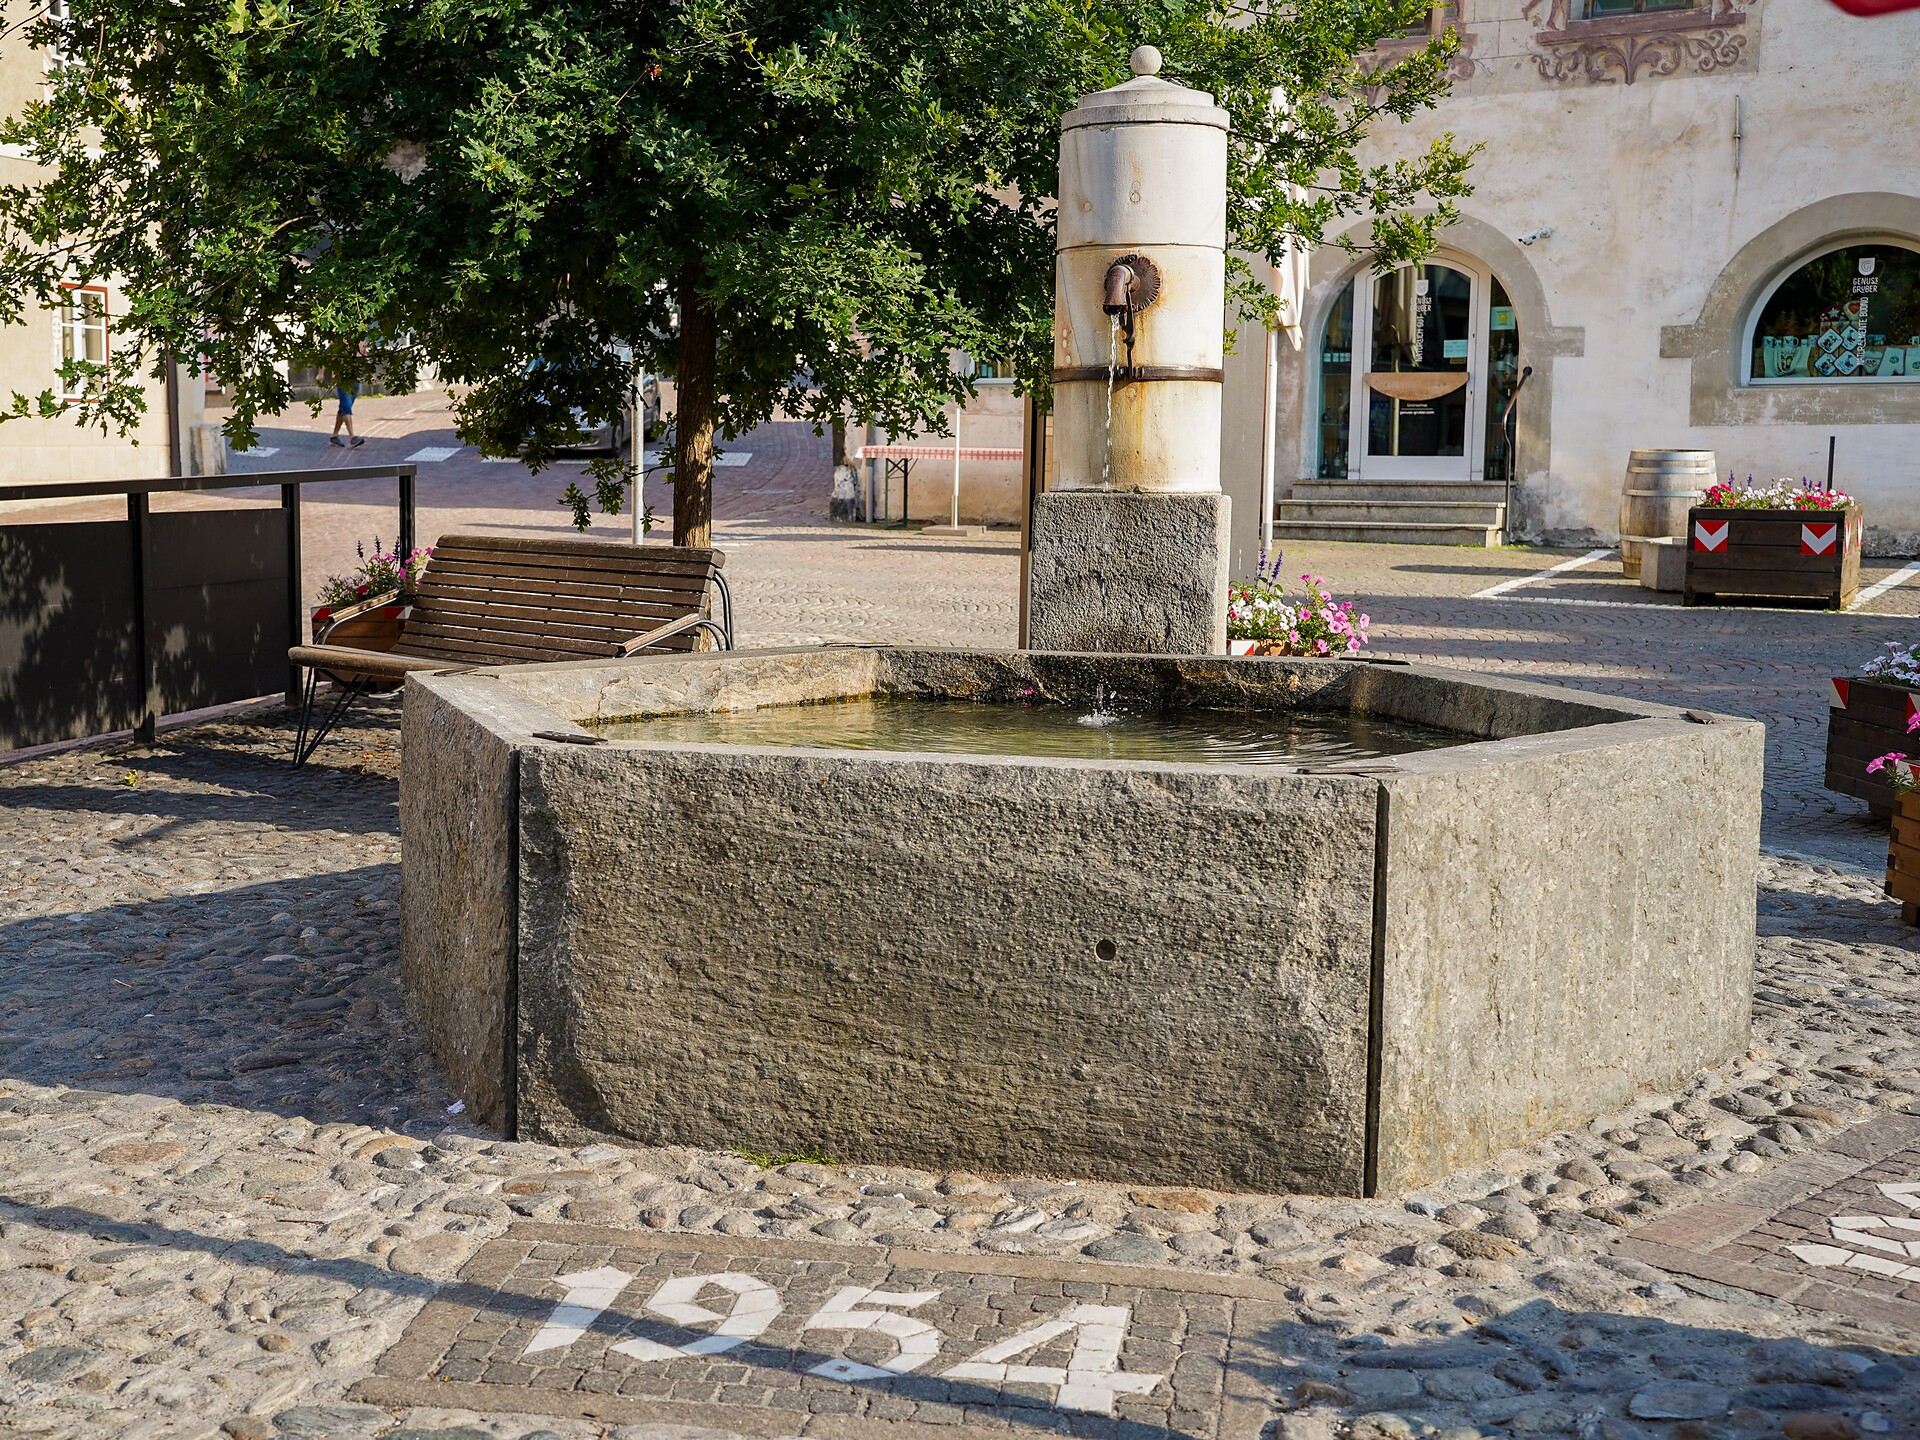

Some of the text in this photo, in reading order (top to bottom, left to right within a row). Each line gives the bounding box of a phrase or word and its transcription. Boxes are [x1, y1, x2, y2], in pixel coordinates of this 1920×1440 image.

[1852, 285, 1878, 294] GRUBER
[1856, 296, 1869, 366] NATURALMENTE BUONO
[522, 1266, 1163, 1413] 1954
